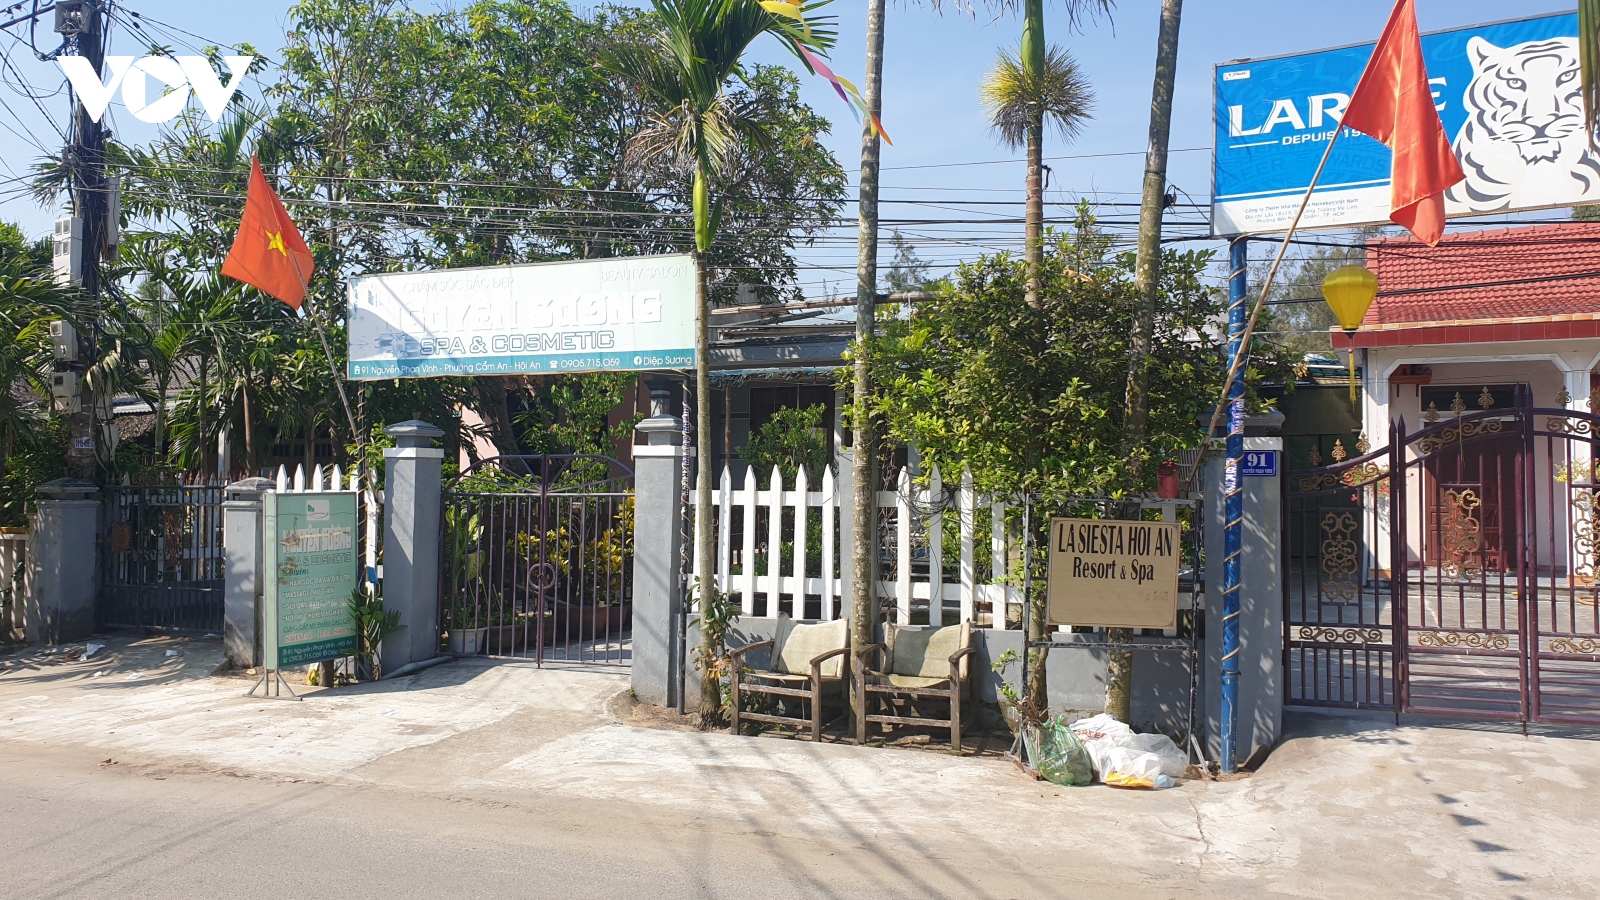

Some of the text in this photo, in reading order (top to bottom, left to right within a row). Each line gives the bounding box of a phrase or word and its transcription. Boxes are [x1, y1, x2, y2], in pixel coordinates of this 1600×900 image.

[1228, 76, 1447, 138] LARE
[1281, 130, 1336, 146] DEPUIS
[601, 265, 688, 282] BEAUTY SALON
[376, 294, 518, 335] GUYÊN
[420, 330, 615, 355] SPA & COSMETIC
[361, 366, 369, 374] 91
[371, 364, 399, 376] Nguyễn
[401, 365, 420, 373] Phan
[444, 363, 474, 373] Phường
[497, 362, 508, 370] An
[529, 361, 541, 369] An
[560, 358, 620, 369] 0905.715.059
[643, 355, 693, 366] Diệp Sương
[1247, 453, 1268, 467] 91
[1058, 523, 1173, 557] LA SIESTA HOI AN
[303, 555, 309, 567] &
[310, 552, 352, 566] COSMETIC
[1072, 556, 1154, 585] Resort & Spa
[285, 590, 310, 599] MASSAGE
